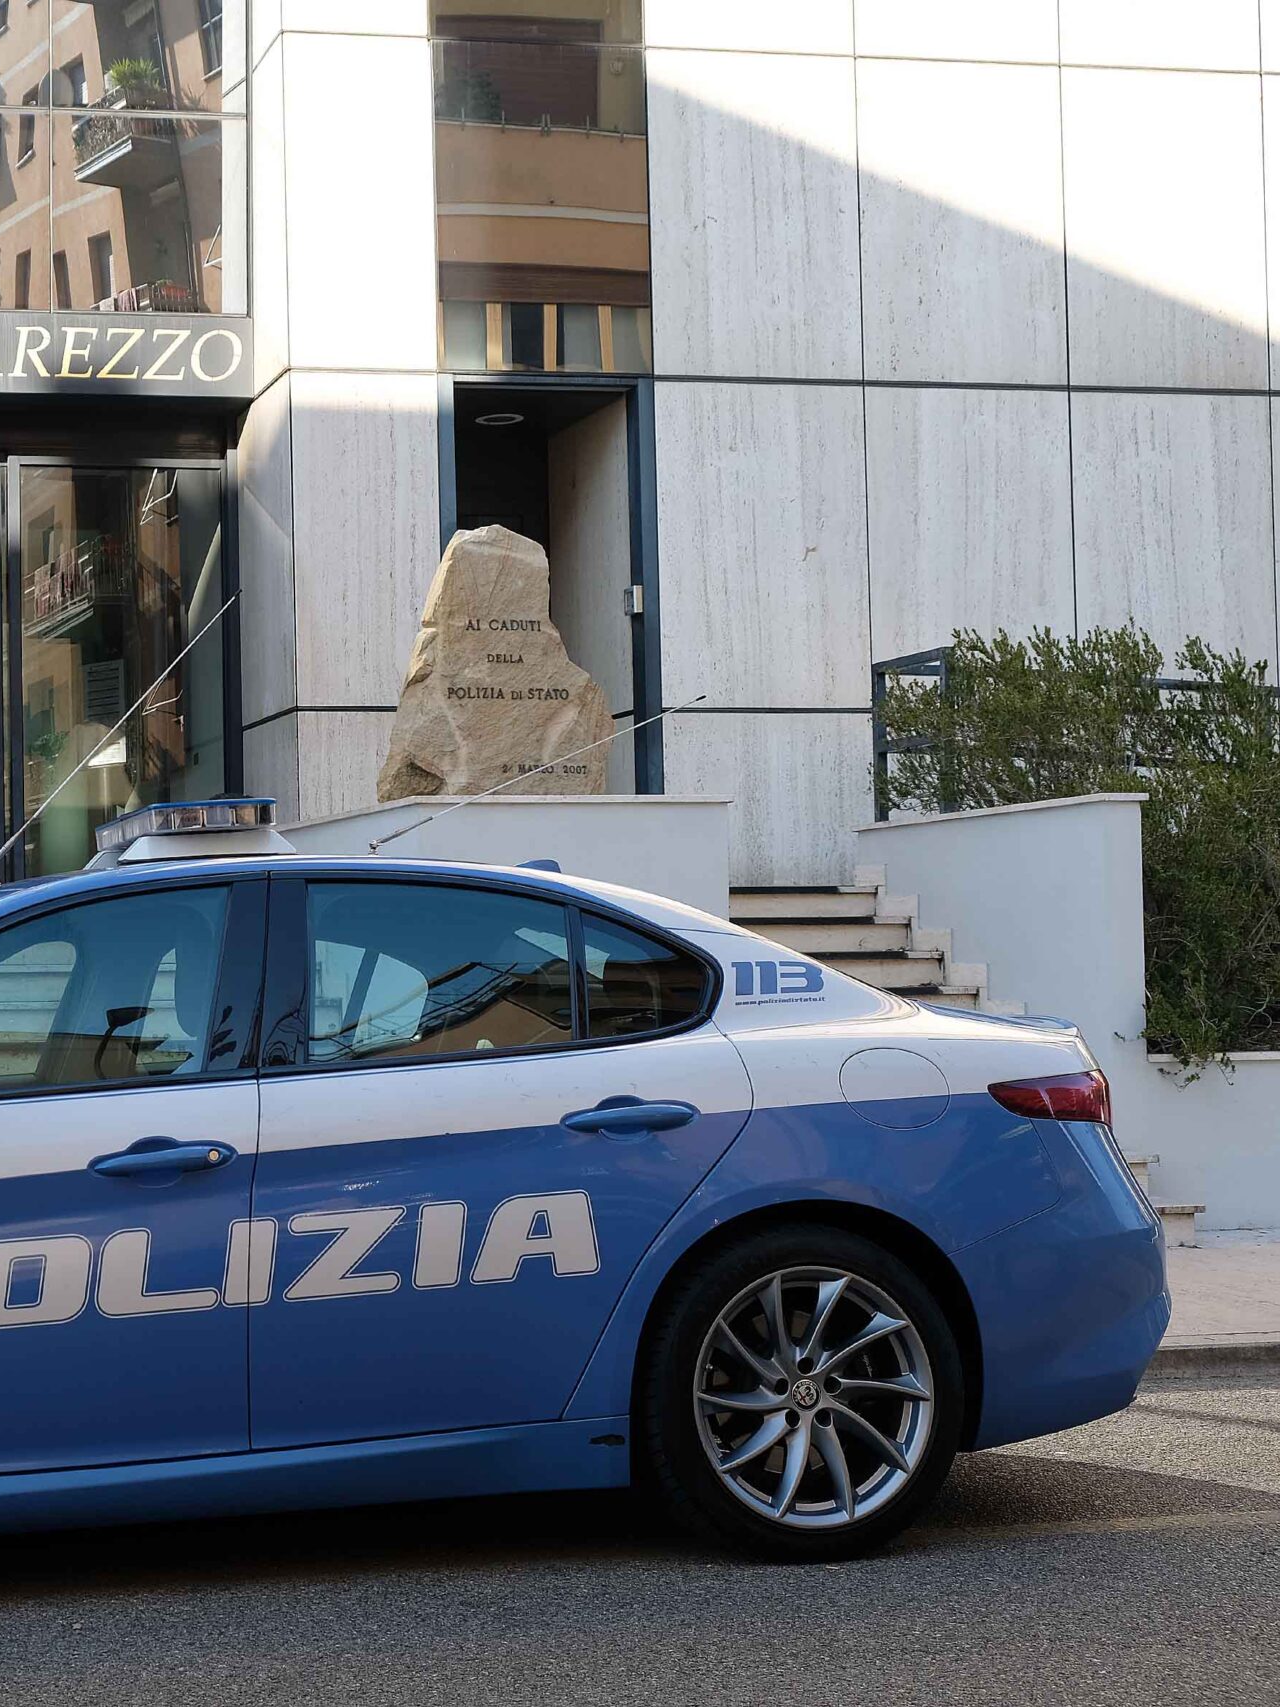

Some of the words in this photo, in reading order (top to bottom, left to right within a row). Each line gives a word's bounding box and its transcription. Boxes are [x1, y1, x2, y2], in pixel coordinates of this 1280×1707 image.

[465, 619, 481, 631] AI
[488, 618, 542, 632] CADUTI
[487, 653, 525, 664] DELLA
[447, 687, 505, 700] POLIZIA
[526, 688, 570, 700] STATO
[730, 960, 824, 996] 113
